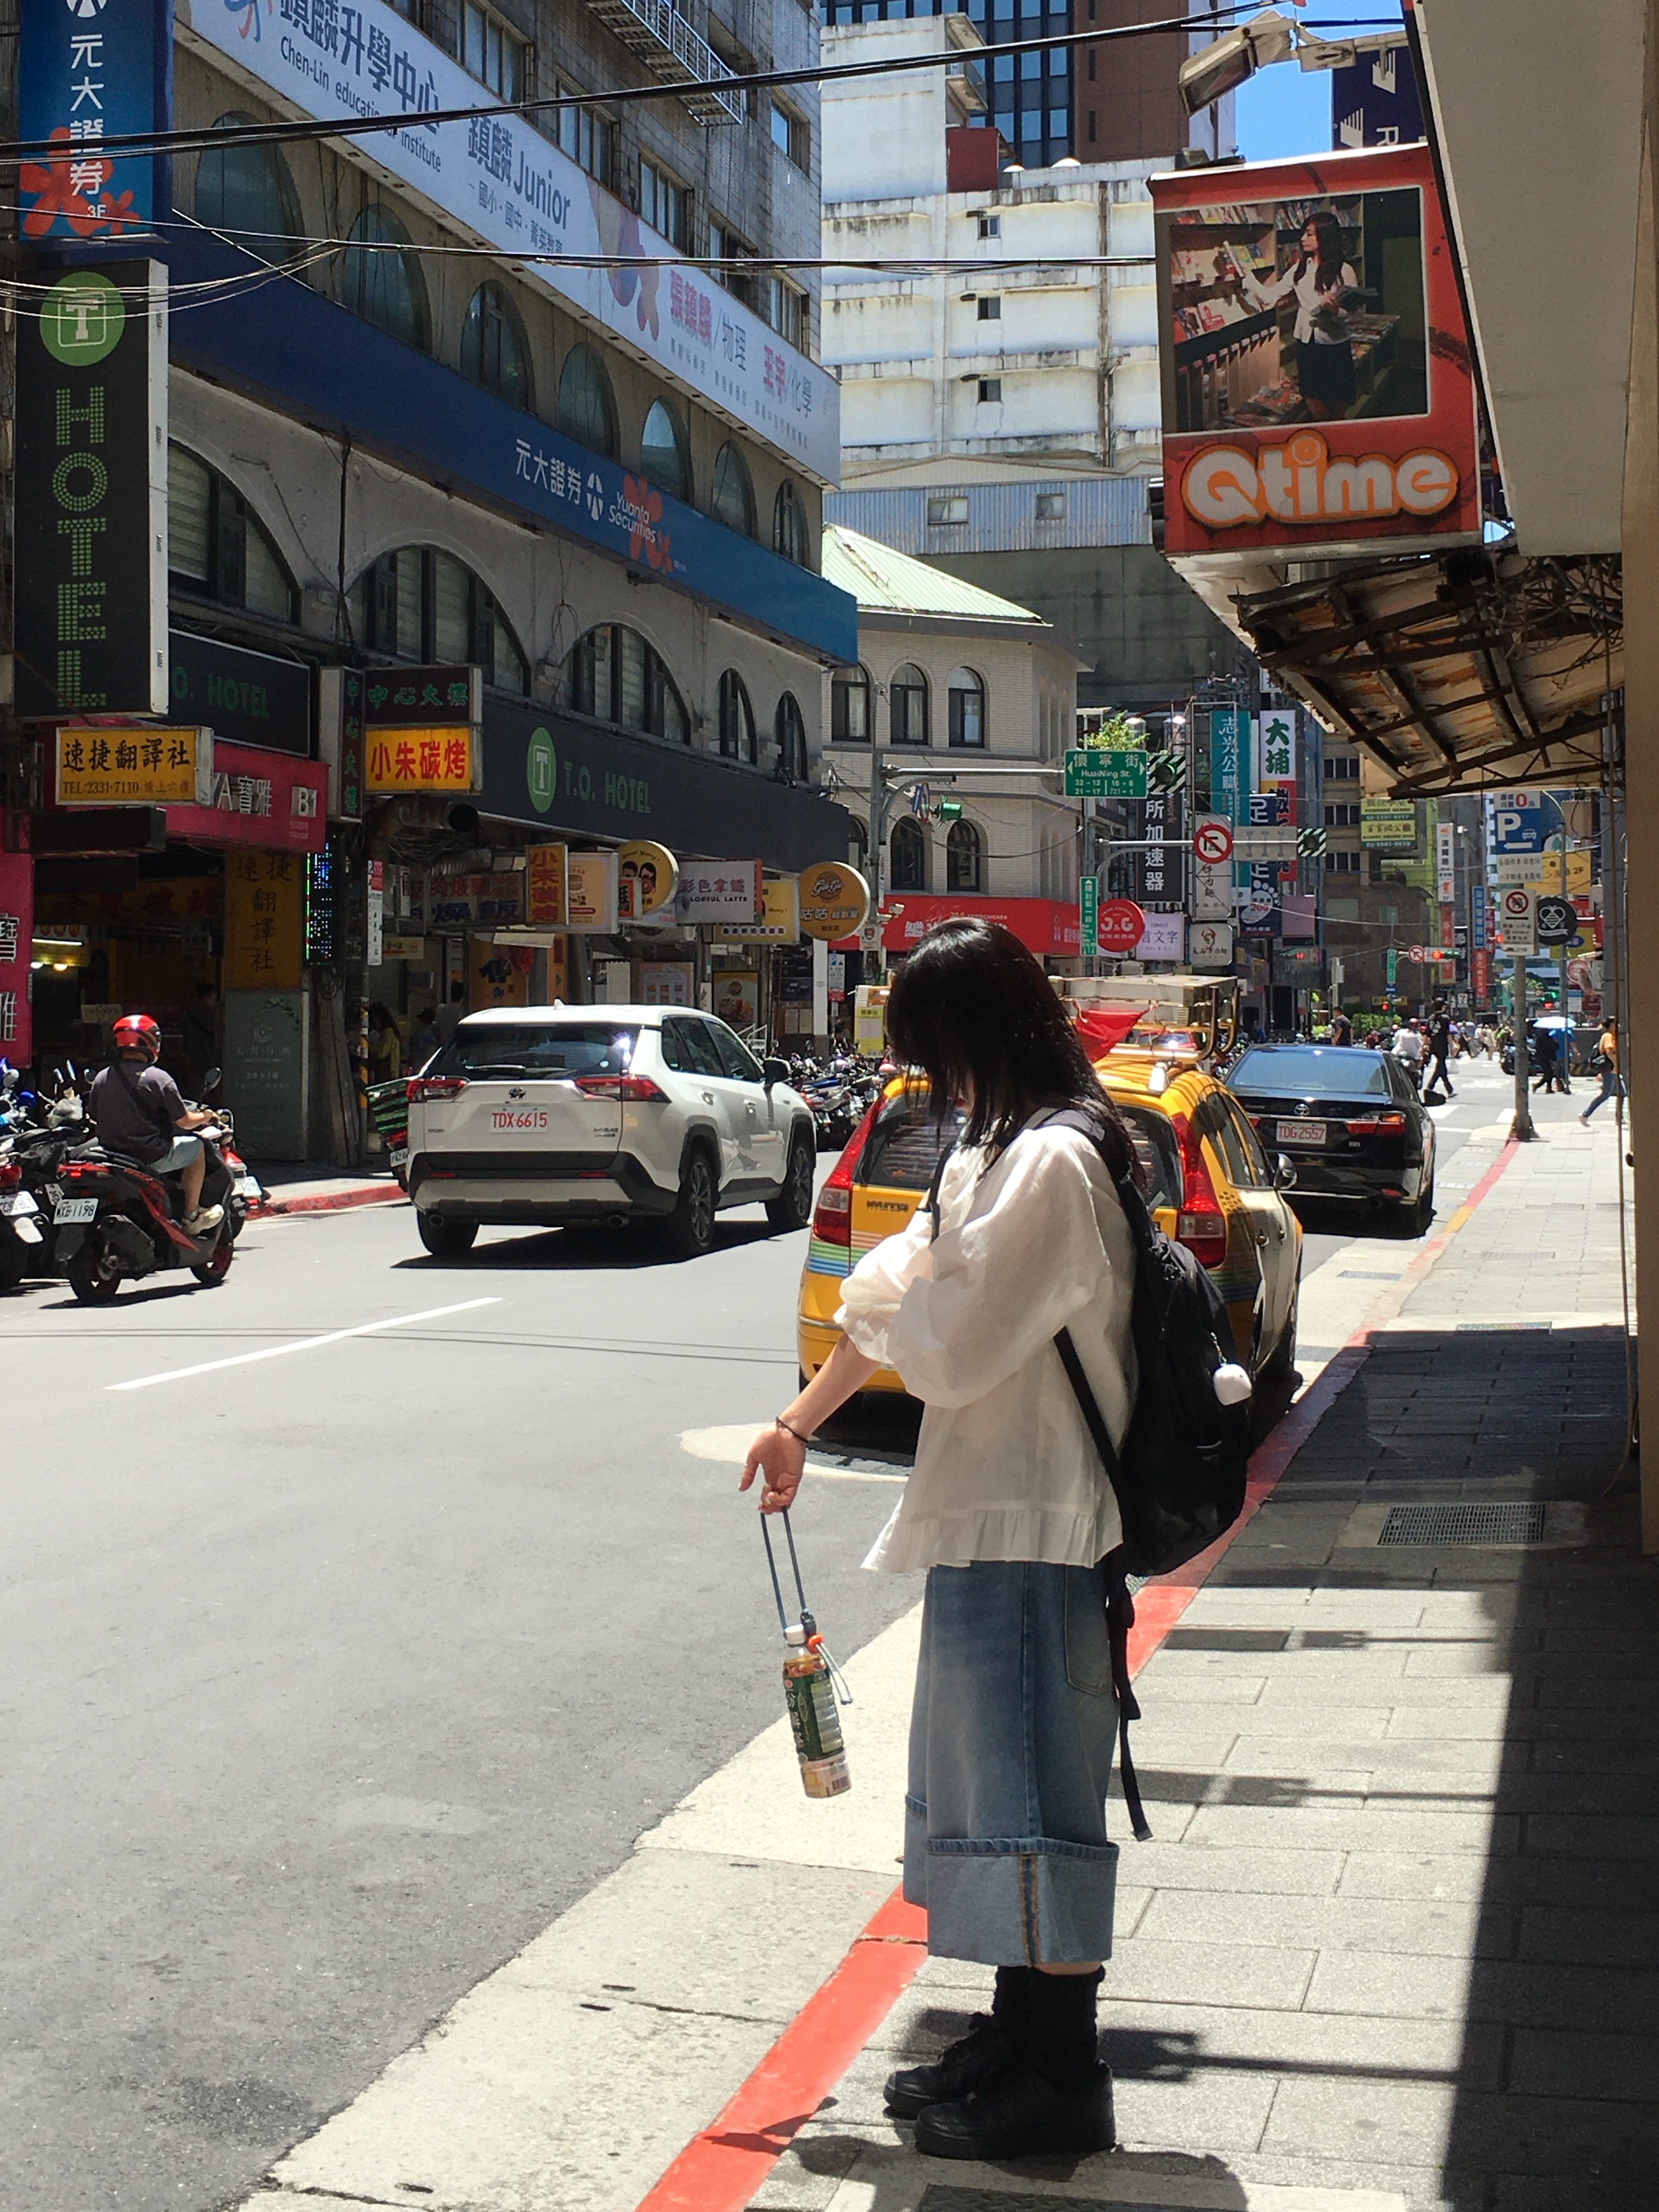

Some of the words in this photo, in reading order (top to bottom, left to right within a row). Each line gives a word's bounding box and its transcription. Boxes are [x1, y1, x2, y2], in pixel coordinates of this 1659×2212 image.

[281, 36, 330, 91] Chen-Lin
[70, 34, 104, 196] 元大證券
[514, 150, 571, 230] Junior
[516, 438, 582, 505] 元大證券
[1187, 436, 1454, 523] Qtime
[608, 504, 656, 543] Securities
[616, 492, 650, 524] Yuanta
[53, 386, 108, 707] HOTEL
[208, 674, 270, 719] HOTEL
[368, 682, 469, 709] 中心大樓
[63, 738, 190, 773] 速捷翻譯社
[344, 677, 359, 814] 中心大樓
[370, 739, 467, 782] 小朱碳烤
[605, 773, 652, 814] HOTEL
[1082, 770, 1118, 779] HuaiNing
[238, 775, 273, 817] 寶雅
[299, 787, 317, 818] B1
[1497, 812, 1521, 841] P
[1100, 917, 1133, 932] J&G
